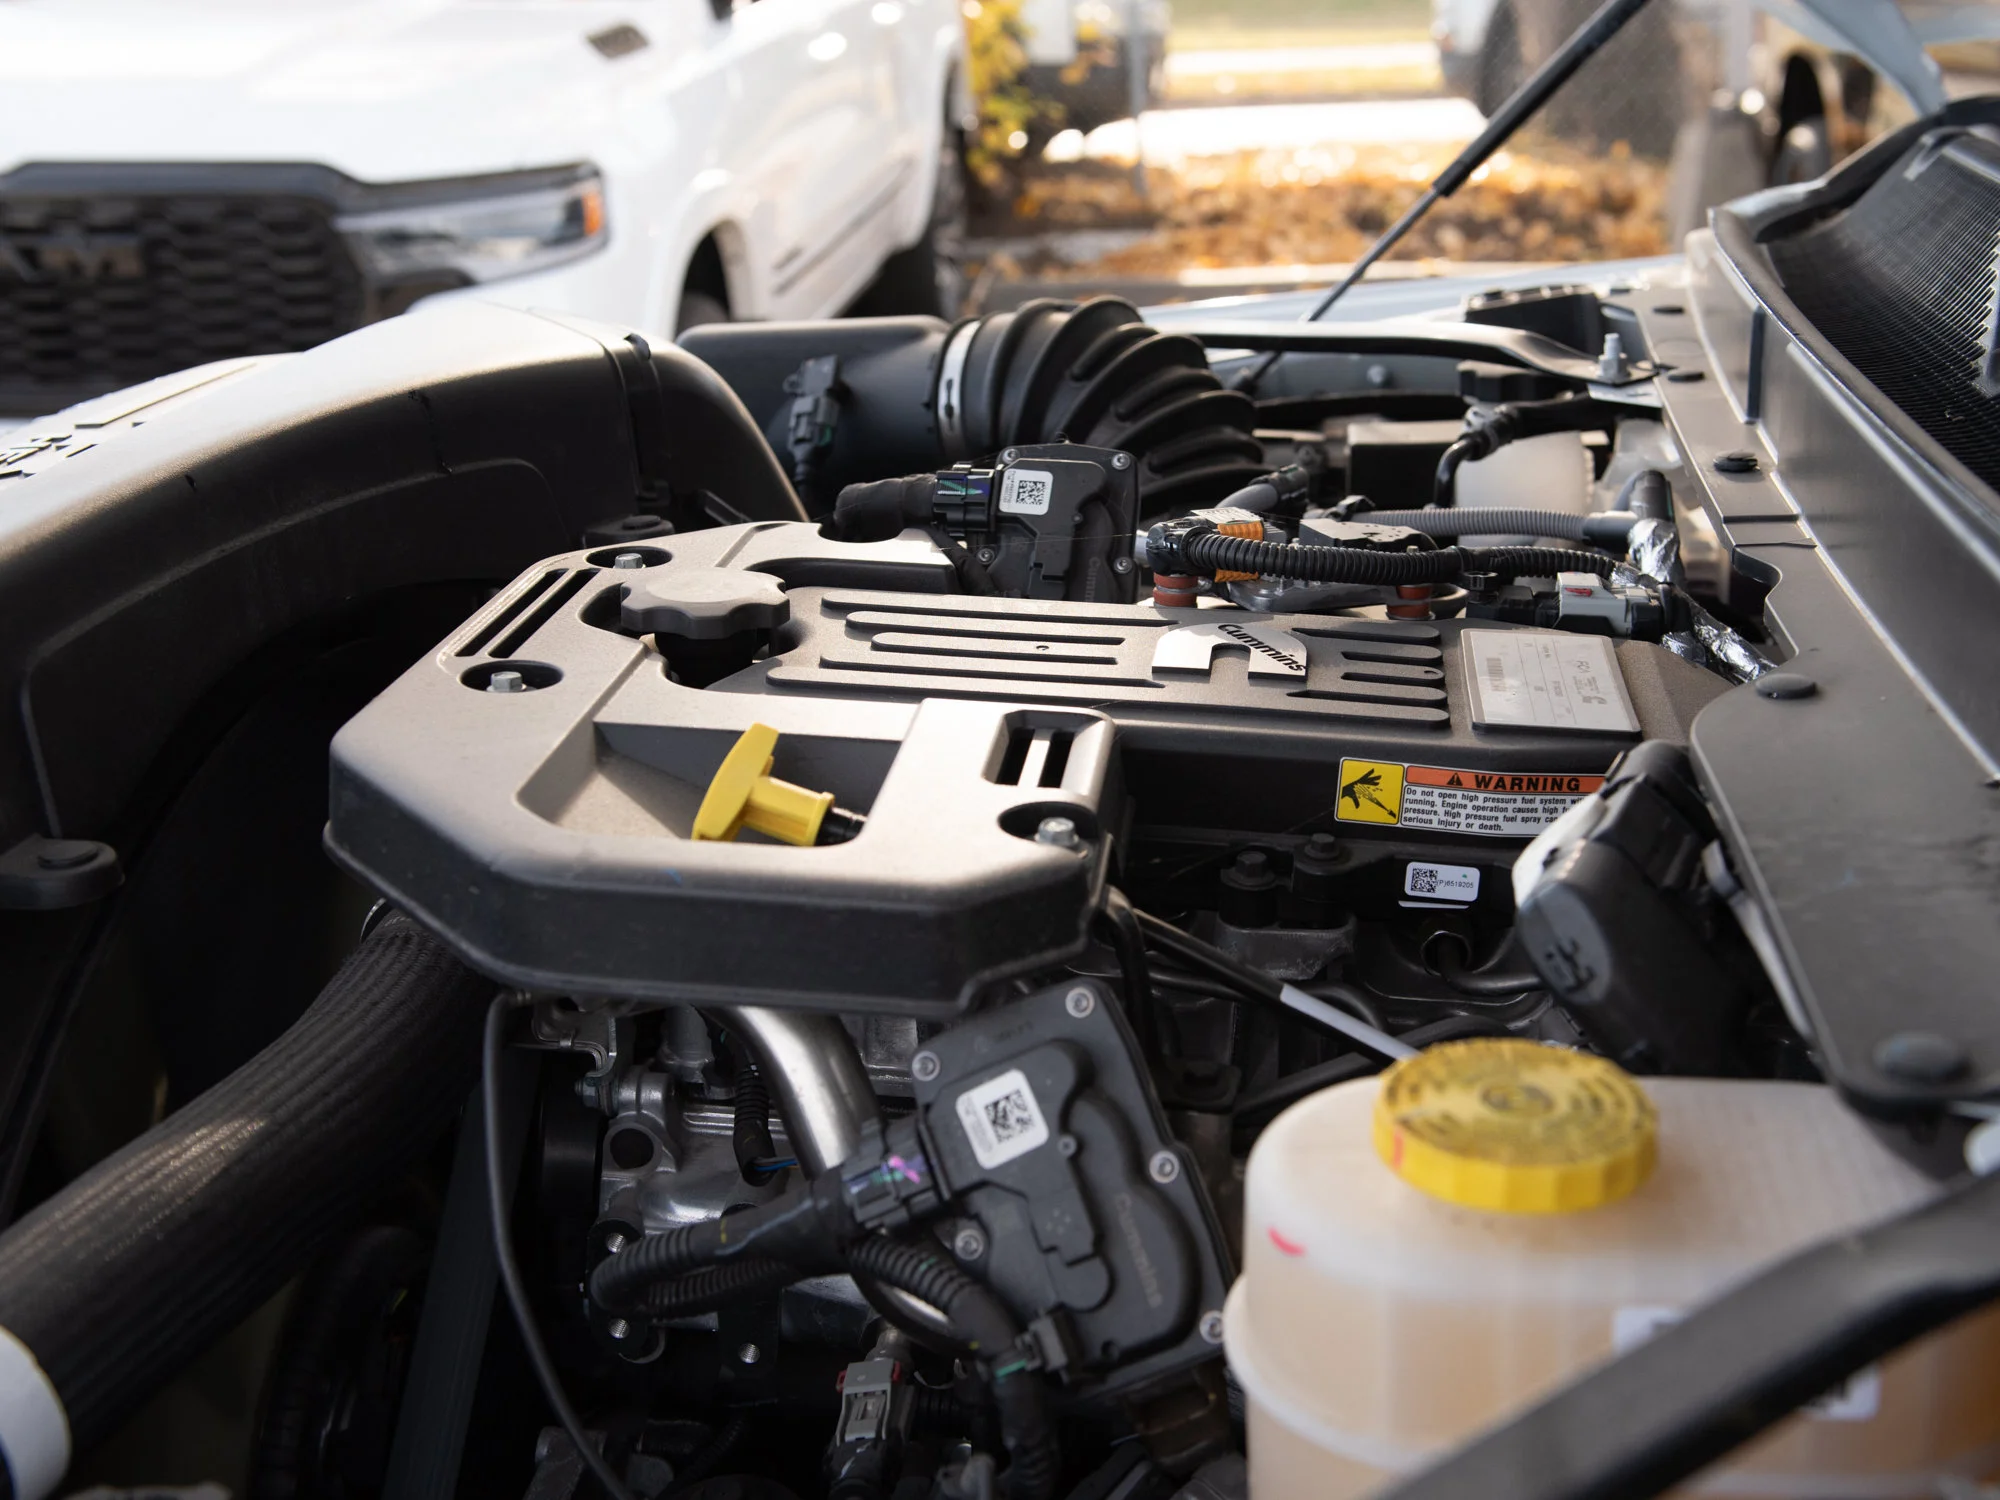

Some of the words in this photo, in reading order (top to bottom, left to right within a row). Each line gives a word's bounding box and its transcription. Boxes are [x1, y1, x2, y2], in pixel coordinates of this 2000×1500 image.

[1085, 556, 1101, 602] Cumm
[1218, 624, 1306, 672] Cummins
[1474, 774, 1580, 791] WARNING
[1406, 787, 1417, 796] Do
[1421, 789, 1434, 797] not
[1438, 791, 1457, 800] open
[1461, 793, 1479, 802] high
[1483, 795, 1517, 805] pressure
[1521, 796, 1536, 805] fuel
[1539, 797, 1566, 805] system
[1404, 806, 1440, 817] pressure.
[1444, 809, 1461, 819] High
[1465, 812, 1499, 822] pressure
[1502, 814, 1518, 823] fuel
[1520, 816, 1541, 824] spray
[1405, 797, 1437, 808] running.
[1441, 800, 1467, 810] Engine
[1471, 804, 1508, 813] operation
[1512, 806, 1538, 814] causes
[1542, 804, 1558, 815] high
[1403, 816, 1433, 825] serious
[1437, 818, 1461, 828] injury
[1478, 822, 1504, 832] death.
